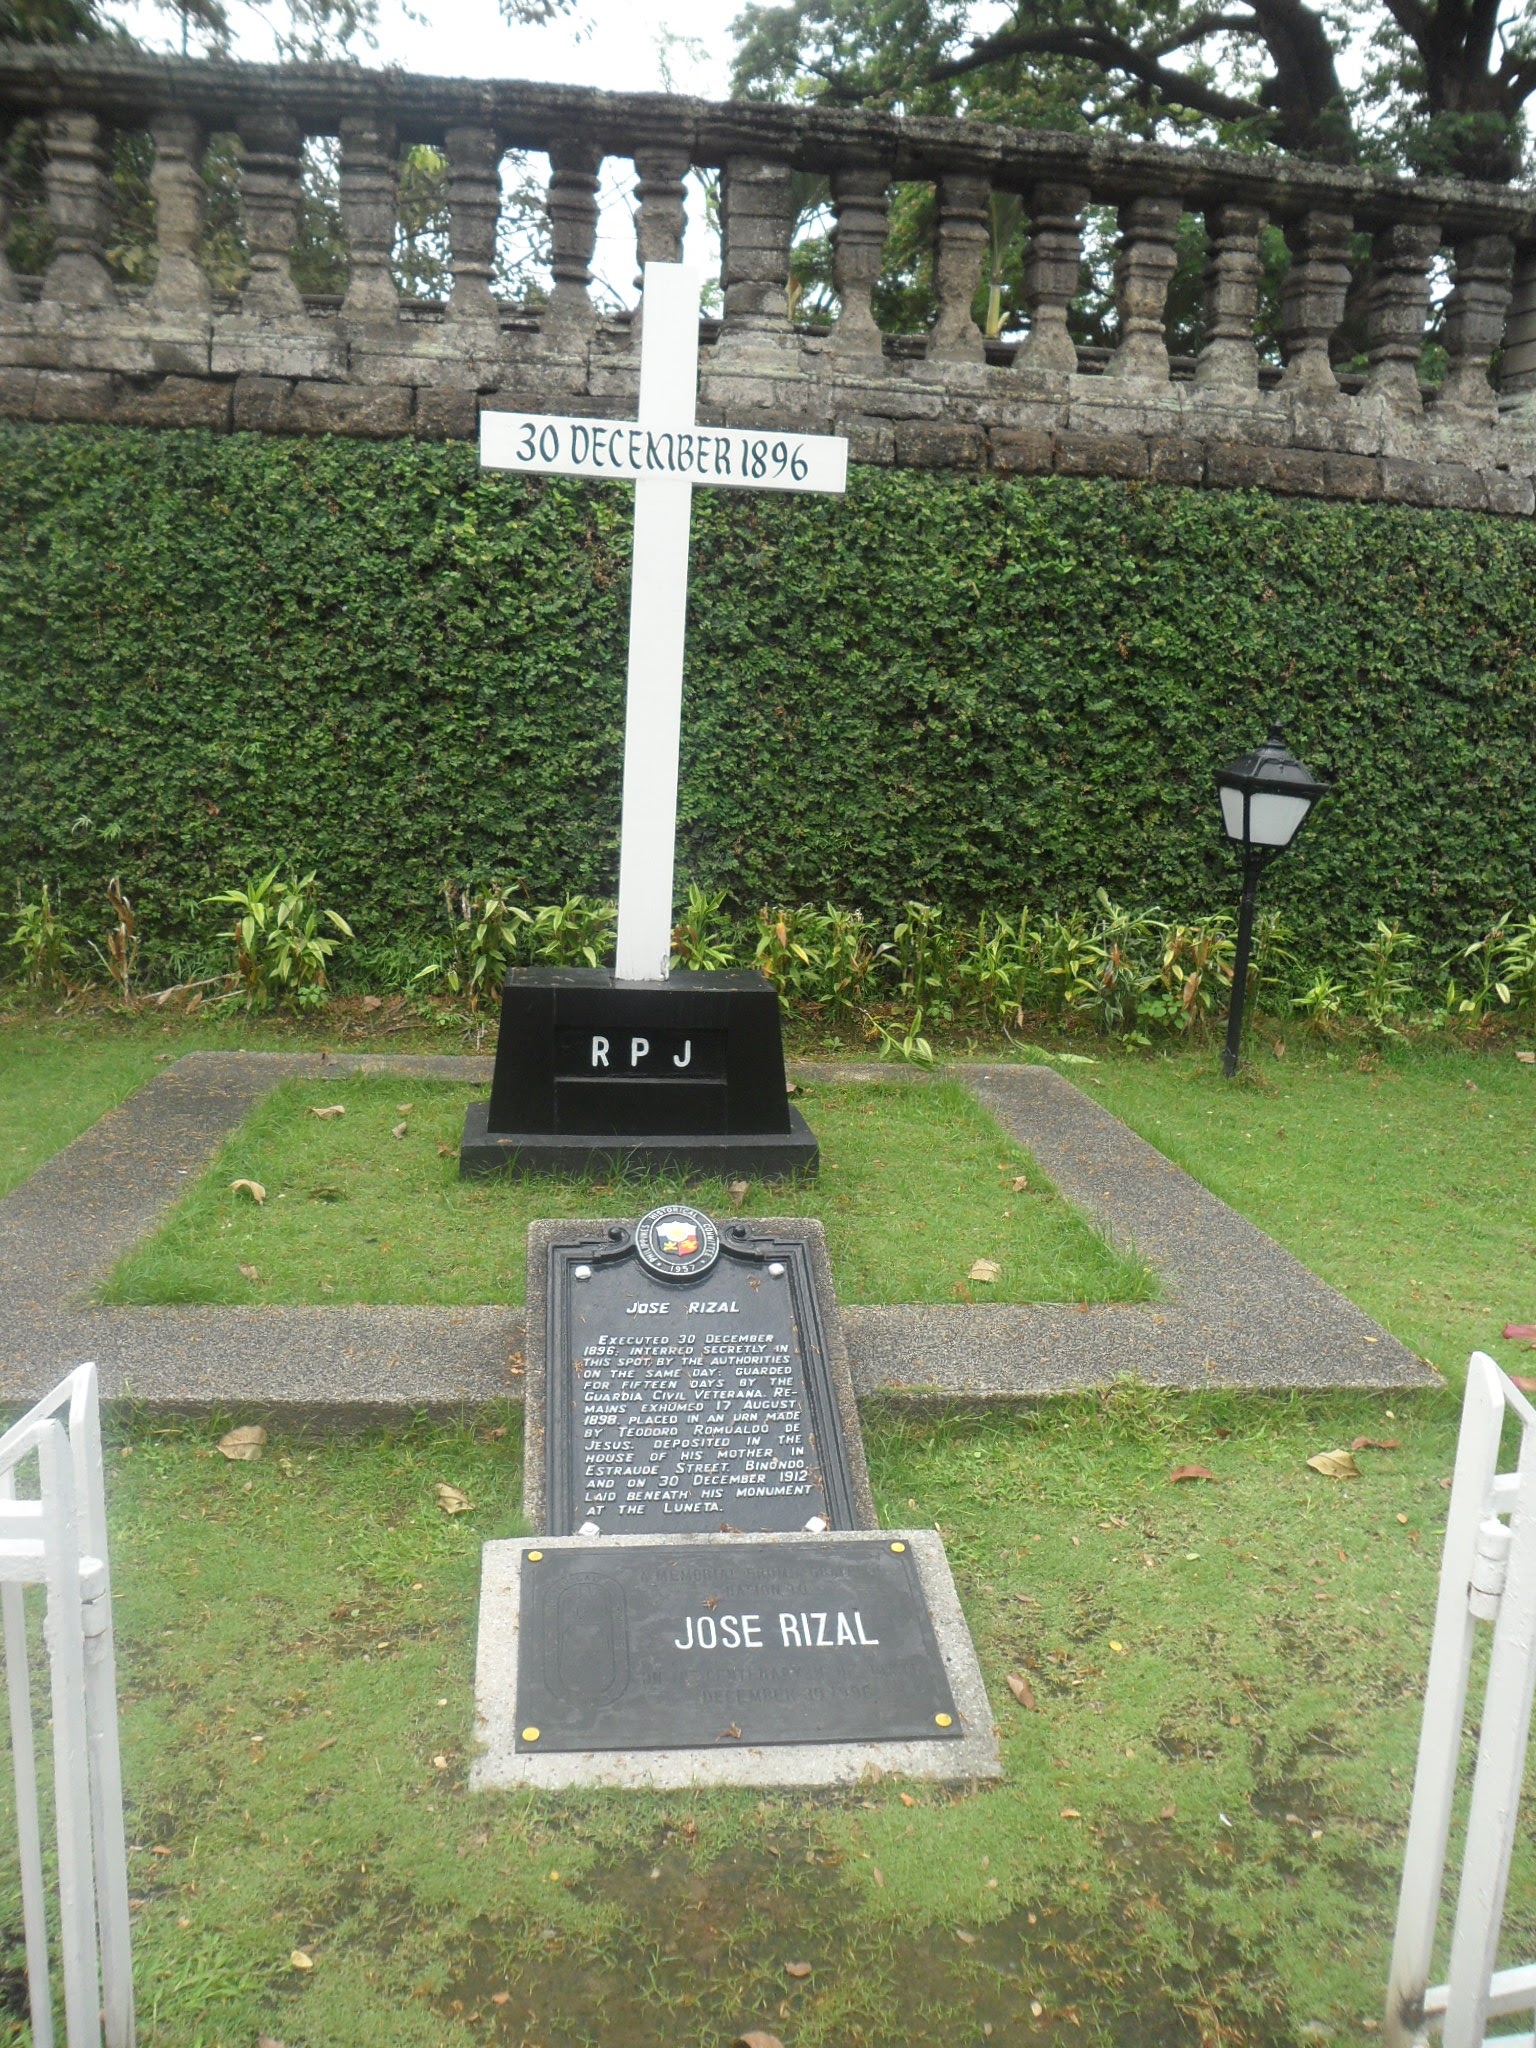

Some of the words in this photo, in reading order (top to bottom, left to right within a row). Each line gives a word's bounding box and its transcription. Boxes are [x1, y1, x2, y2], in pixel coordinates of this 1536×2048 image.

[516, 422, 559, 462] 30
[570, 424, 731, 476] DECEMBER
[742, 438, 809, 481] 1896
[592, 1035, 609, 1066] R
[631, 1037, 649, 1066] P
[673, 1040, 691, 1067] J
[649, 1207, 698, 1220] HISTORICAL
[626, 1302, 670, 1314] JOSE
[688, 1301, 740, 1313] RIZAL
[598, 1335, 669, 1345] EXECUTED
[678, 1335, 695, 1344] 30
[705, 1334, 774, 1344] DECEMBER
[630, 1347, 694, 1356] INTERRED
[703, 1345, 767, 1354] SECRETLY
[774, 1345, 789, 1353] IN
[583, 1358, 611, 1367] THIS
[656, 1358, 675, 1366] BY
[682, 1357, 704, 1366] THE
[710, 1356, 791, 1365] AUTHORITIES
[584, 1370, 602, 1379] ON
[610, 1370, 635, 1378] THE
[645, 1369, 681, 1378] SAME
[735, 1367, 792, 1375] GUARDED
[584, 1381, 610, 1390] FOR
[622, 1381, 677, 1389] FIFTEEN
[690, 1380, 725, 1389] DAYS
[739, 1379, 756, 1388] BY
[770, 1377, 794, 1386] THE
[584, 1392, 643, 1402] GUARDIA
[652, 1391, 686, 1401] CIVIL
[774, 1388, 798, 1398] RE-
[584, 1405, 627, 1414] MAINS
[641, 1403, 704, 1412] EXHUMED
[716, 1401, 731, 1411] 17
[743, 1400, 796, 1410] AUGUST
[628, 1416, 678, 1425] PLACED
[687, 1415, 699, 1424] IN
[707, 1414, 724, 1423] AN
[733, 1413, 758, 1422] URN
[766, 1412, 801, 1421] MADE
[584, 1429, 604, 1438] BY
[694, 1425, 769, 1435] ROMUALDO
[785, 1424, 800, 1433] DE
[654, 1438, 730, 1449] DEPOSITED
[746, 1437, 761, 1446] IN
[778, 1435, 802, 1444] THE
[585, 1453, 634, 1463] HOUSE
[650, 1452, 667, 1462] OF
[680, 1451, 703, 1461] HIS
[717, 1449, 773, 1459] MOTHER
[791, 1447, 804, 1456] IN
[585, 1466, 659, 1476] ESTRAUDE
[586, 1479, 615, 1489] AND
[627, 1478, 646, 1488] ON
[658, 1476, 679, 1487] 30
[693, 1474, 766, 1486] DECEMBER
[779, 1471, 808, 1483] 1912
[585, 1492, 616, 1502] LAID
[627, 1491, 689, 1501] BENEATH
[700, 1489, 724, 1499] HIS
[736, 1485, 813, 1498] MONUMENT
[586, 1506, 605, 1516] AT
[618, 1505, 645, 1515] THE
[664, 1502, 723, 1514] LUNETA.
[675, 1614, 763, 1650] JOSE
[778, 1611, 879, 1648] RIZAL
